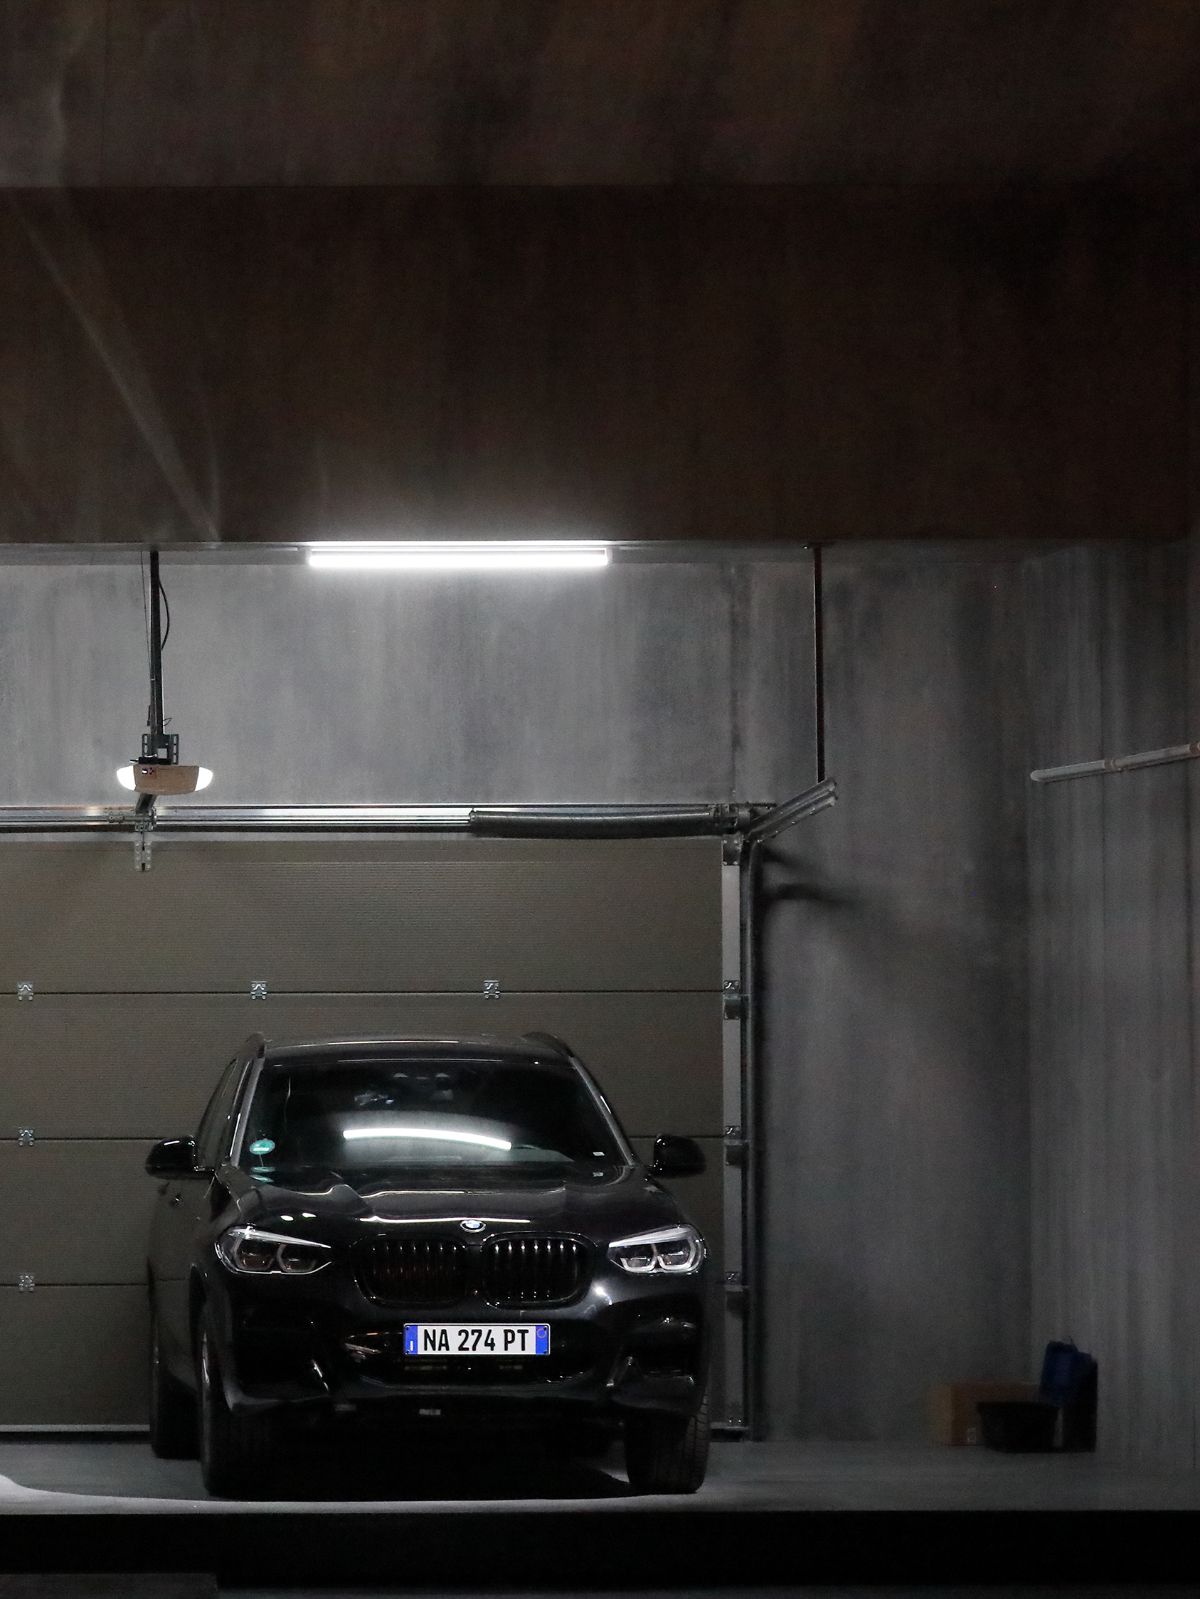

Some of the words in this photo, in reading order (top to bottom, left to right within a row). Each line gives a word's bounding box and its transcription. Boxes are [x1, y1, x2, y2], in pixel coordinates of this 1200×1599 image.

[424, 1329, 450, 1351] NA
[458, 1329, 496, 1351] 274
[504, 1329, 529, 1351] PT
